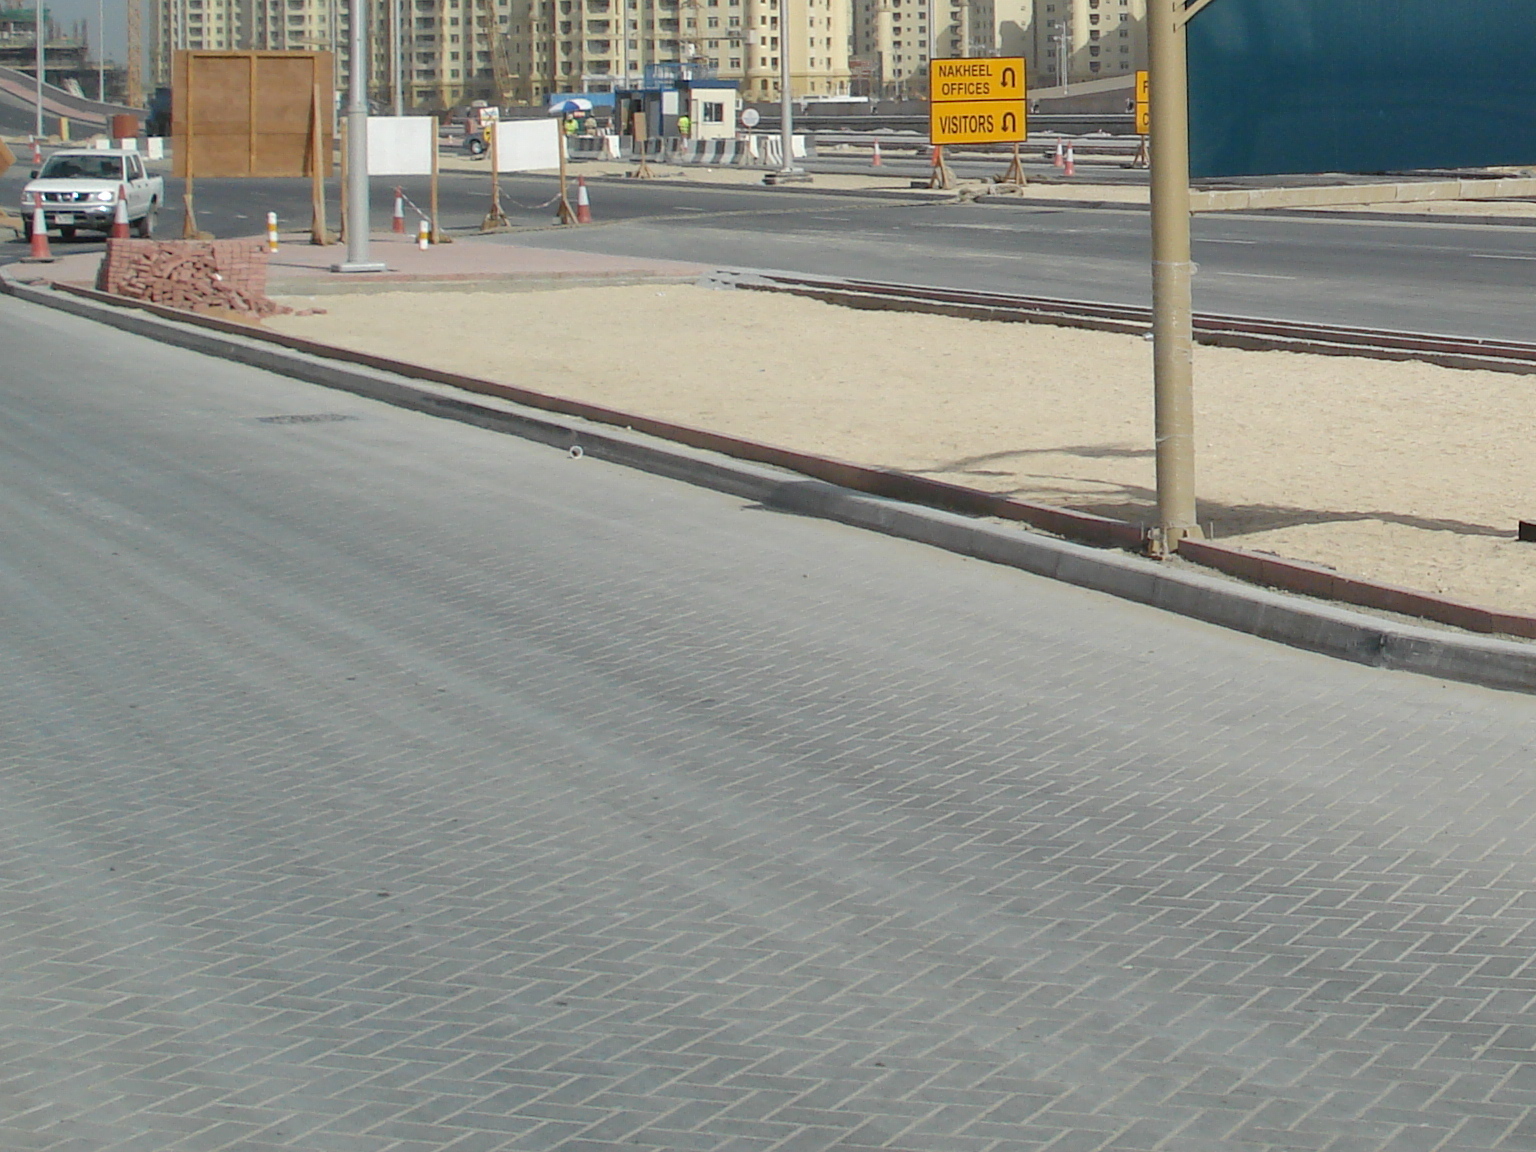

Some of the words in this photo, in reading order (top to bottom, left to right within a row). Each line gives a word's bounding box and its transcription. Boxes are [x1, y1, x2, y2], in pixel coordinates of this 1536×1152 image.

[939, 64, 992, 77] NAKHEEL
[942, 82, 990, 95] OFFICES
[939, 115, 994, 134] VISITORS
